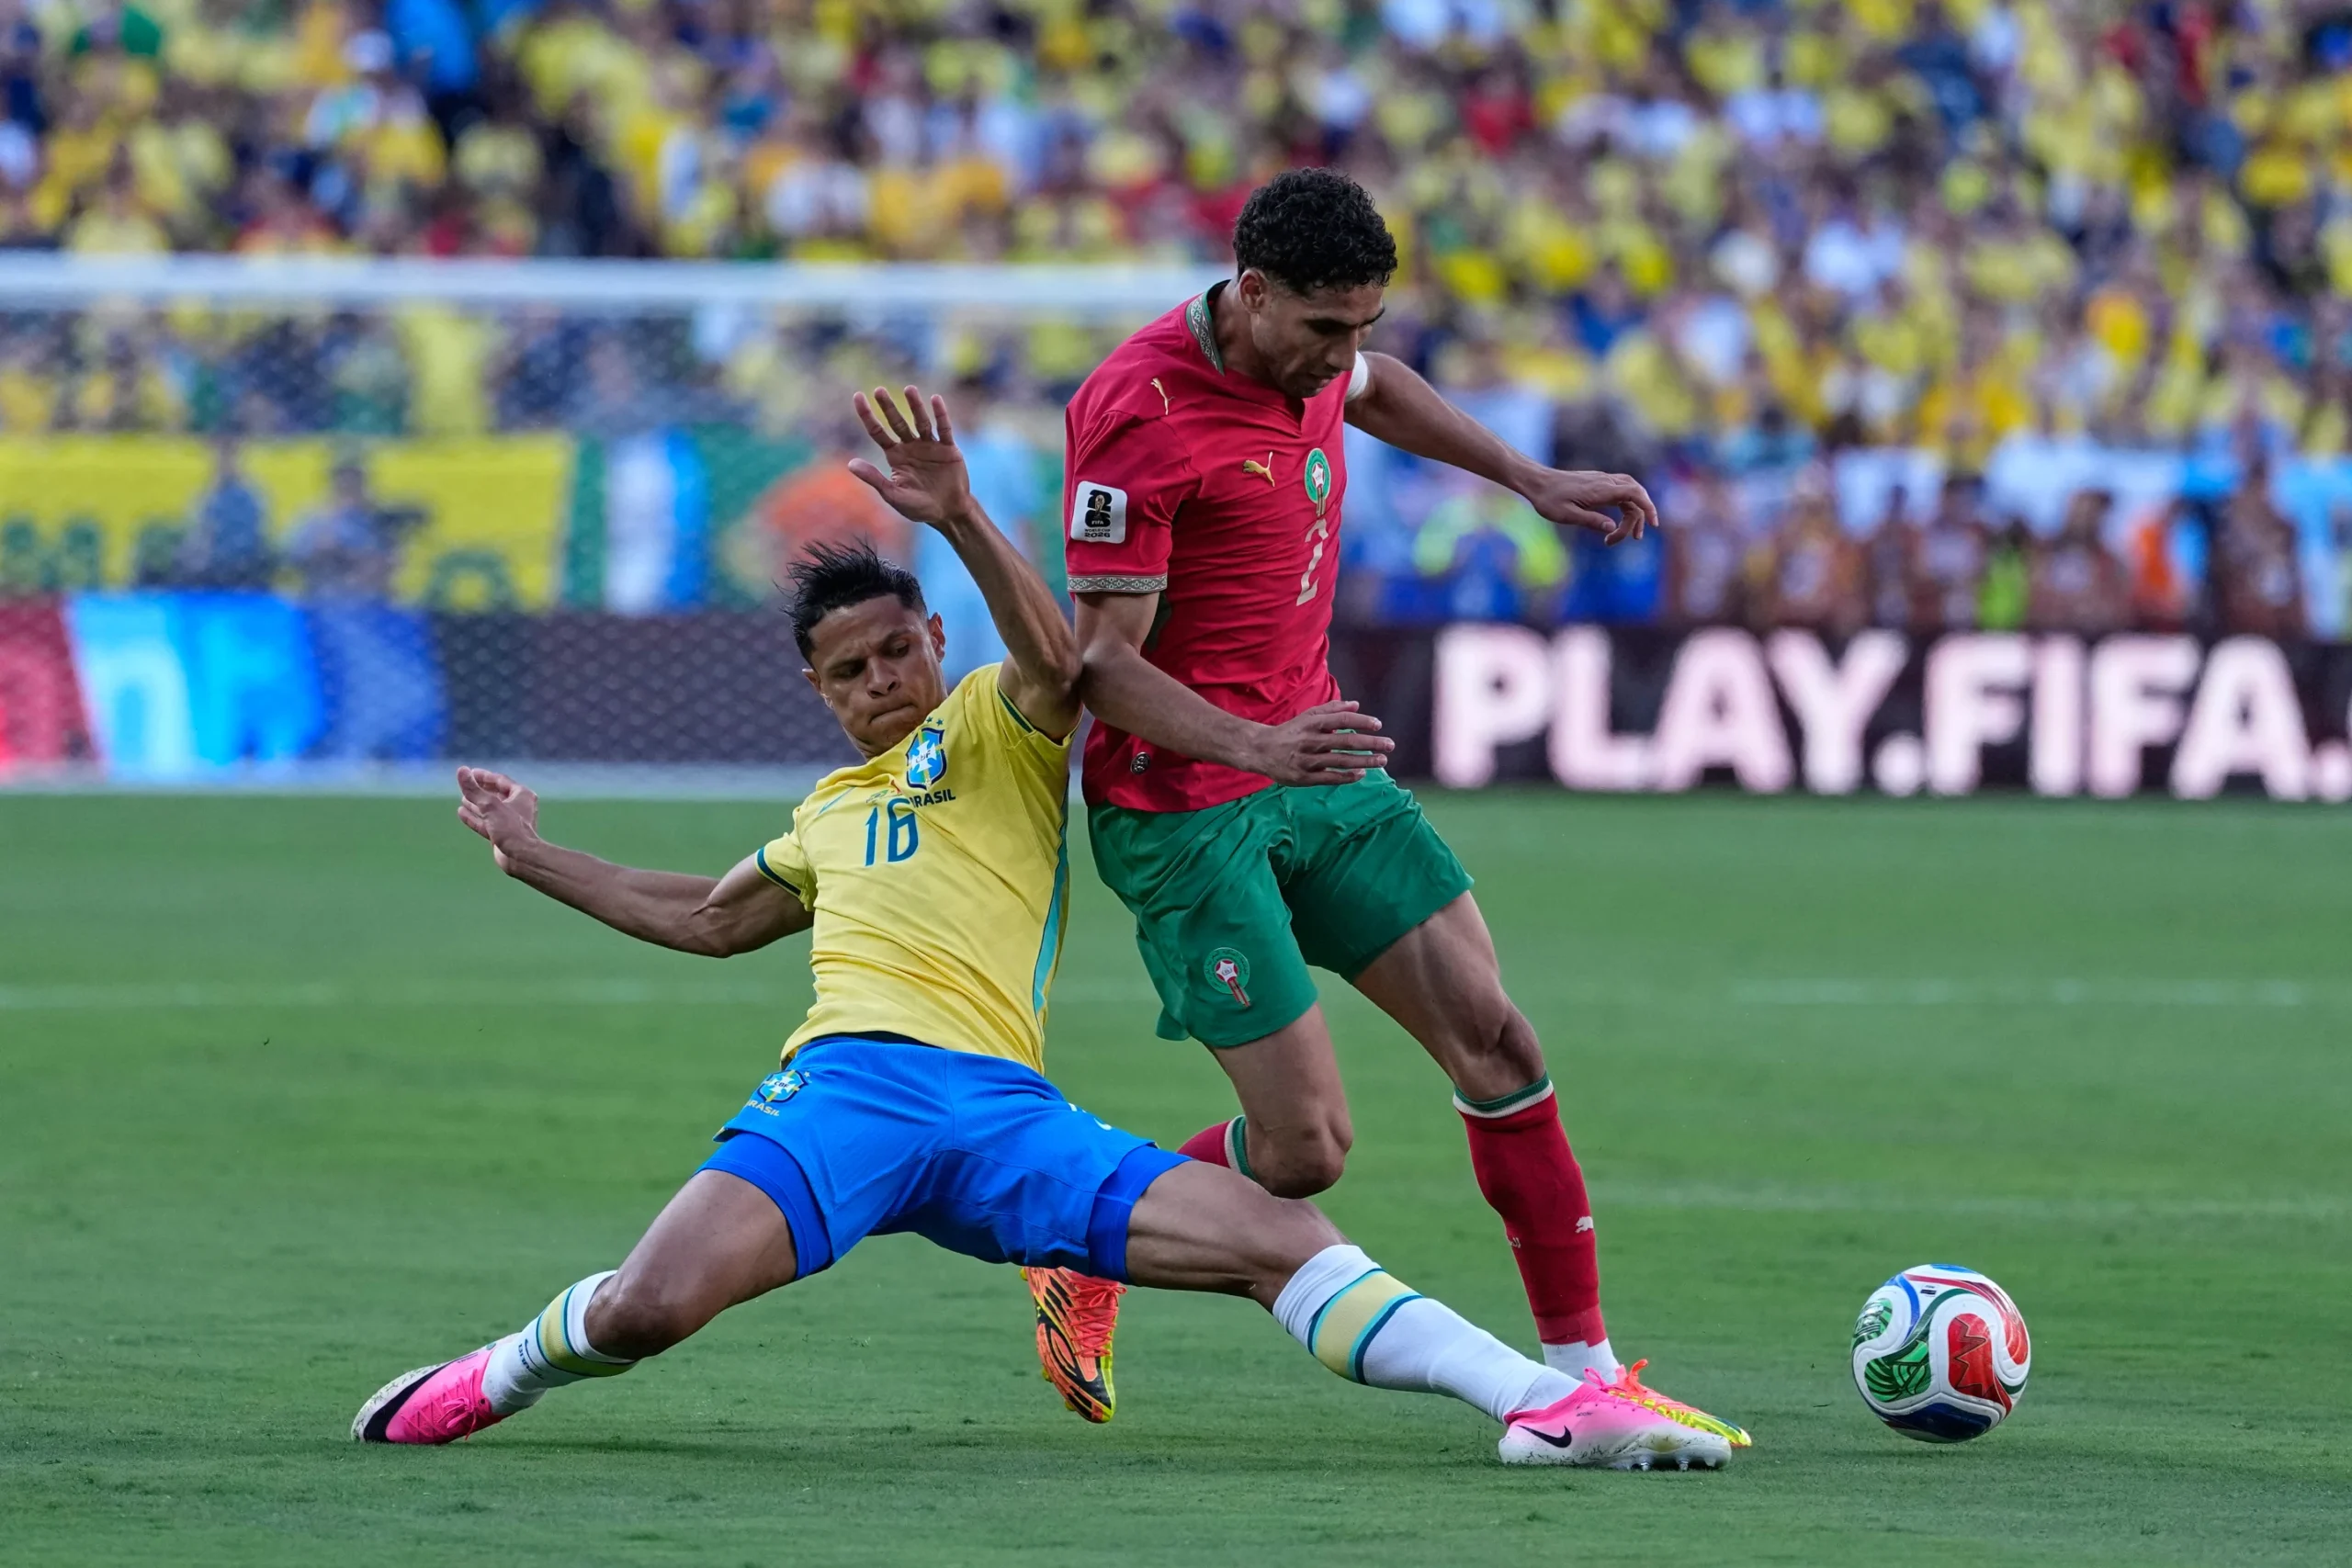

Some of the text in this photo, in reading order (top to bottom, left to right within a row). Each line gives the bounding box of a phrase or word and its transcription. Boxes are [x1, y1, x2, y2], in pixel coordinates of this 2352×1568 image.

[1296, 517, 1329, 607] 2
[1432, 621, 2352, 802] PLAY.FIFA.
[865, 797, 920, 867] 16
[747, 1099, 780, 1117] RASIL
[774, 1080, 790, 1089] CBF
